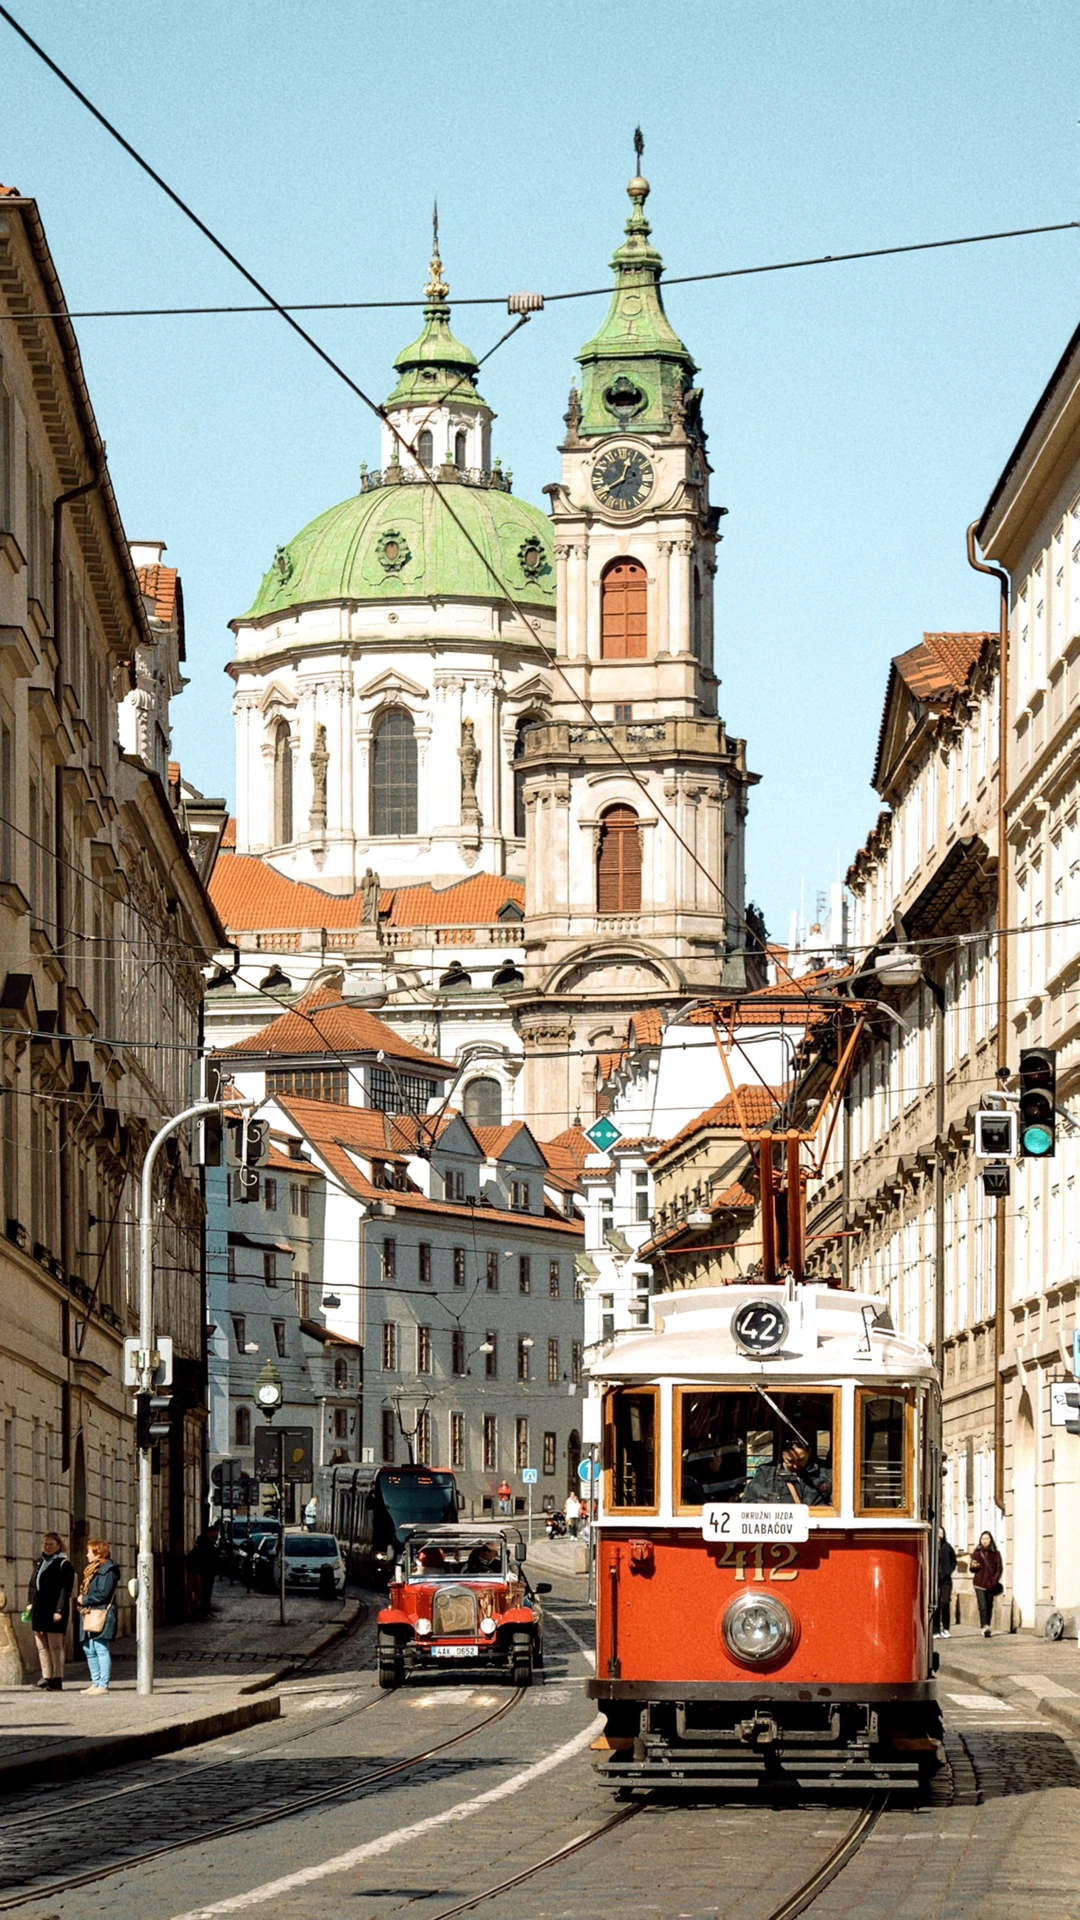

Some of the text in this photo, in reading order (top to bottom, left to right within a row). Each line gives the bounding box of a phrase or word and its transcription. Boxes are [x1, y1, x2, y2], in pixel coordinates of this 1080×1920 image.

[741, 1312, 777, 1341] 42
[709, 1512, 731, 1533] 42
[741, 1521, 793, 1534] DLABAČOV
[718, 1543, 799, 1581] 412
